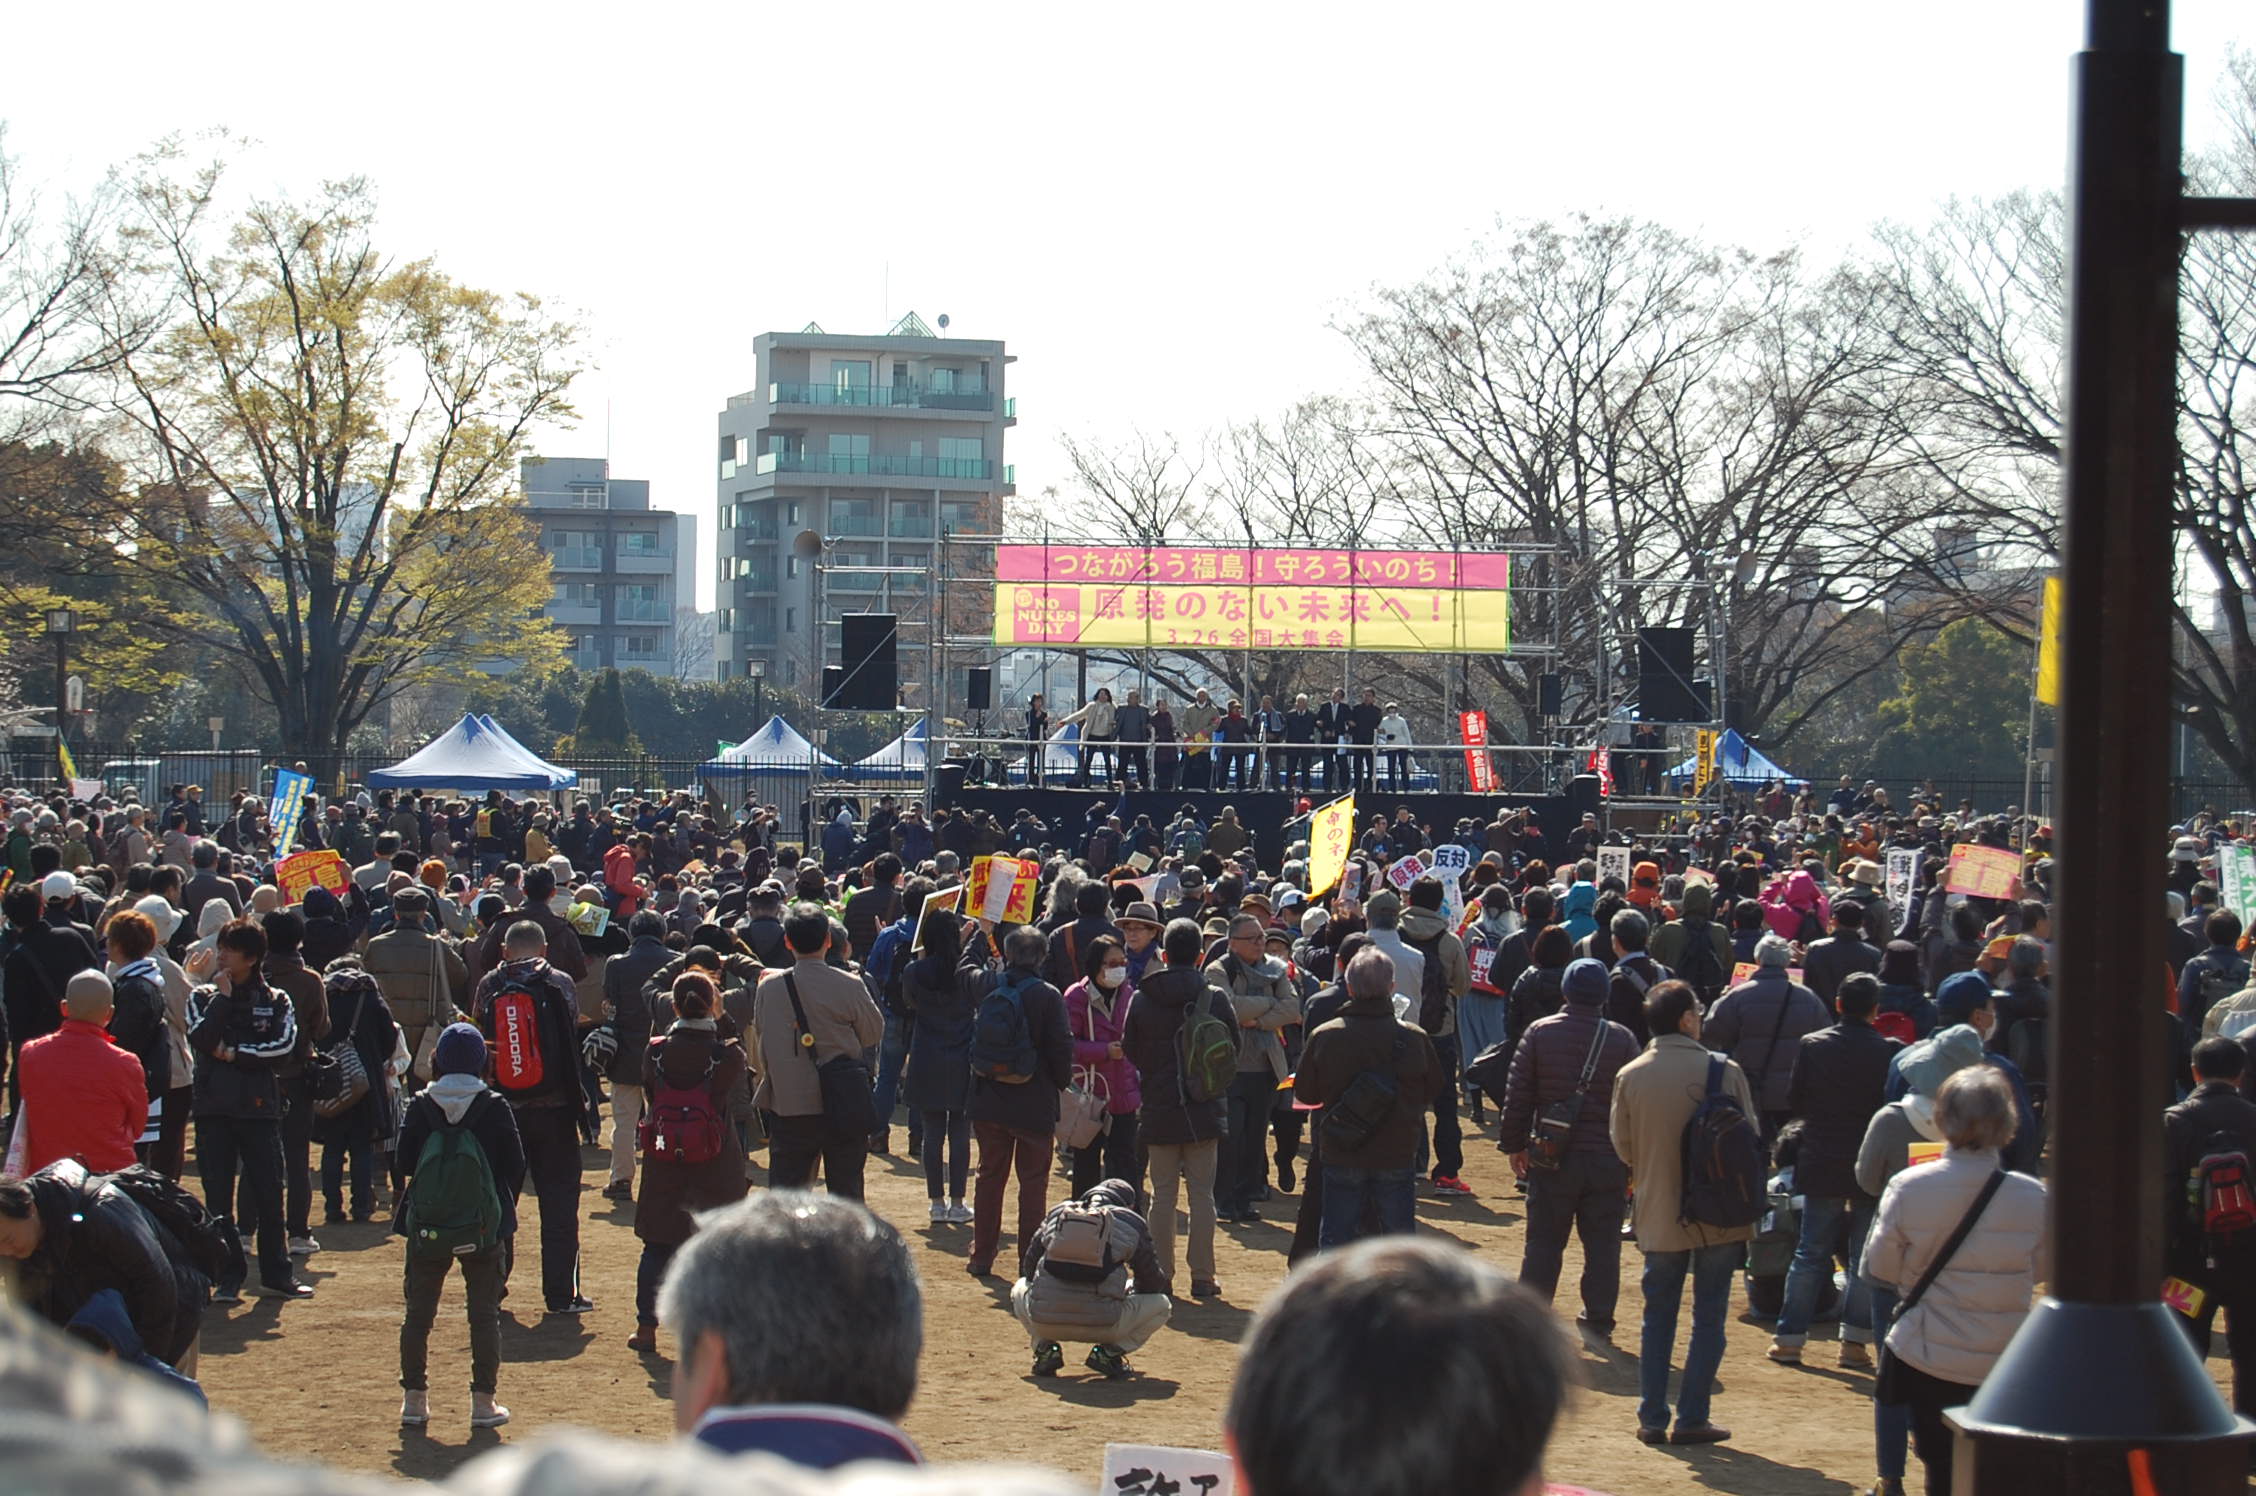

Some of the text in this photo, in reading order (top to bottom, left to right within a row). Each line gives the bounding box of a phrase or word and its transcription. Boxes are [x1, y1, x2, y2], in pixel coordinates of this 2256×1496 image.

[1034, 597, 1060, 610] NO
[1095, 588, 1440, 623] 原発のない未来へ！
[1017, 609, 1077, 622] NUKES
[1027, 621, 1065, 634] DAY
[1435, 849, 1467, 869] 反対
[1390, 858, 1423, 887] 原発
[506, 1005, 523, 1078] DIADORA
